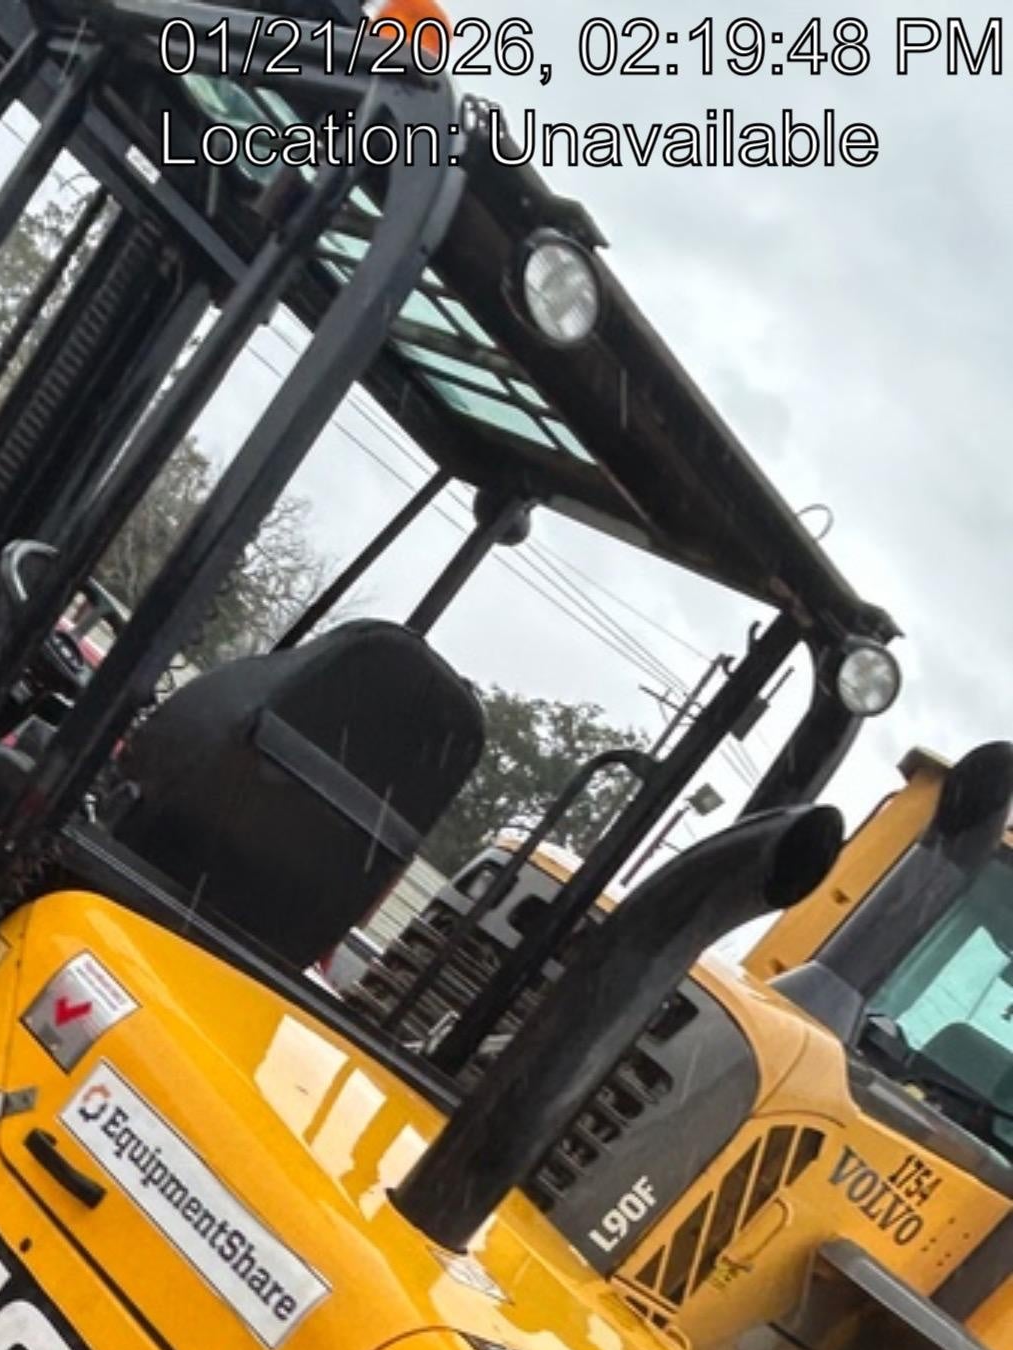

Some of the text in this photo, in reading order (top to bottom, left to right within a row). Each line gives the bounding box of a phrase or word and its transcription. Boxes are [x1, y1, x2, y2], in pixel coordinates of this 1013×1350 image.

[100, 1107, 297, 1323] EquipmentShare
[589, 1175, 658, 1252] L90F
[828, 1144, 924, 1247] VOLVO
